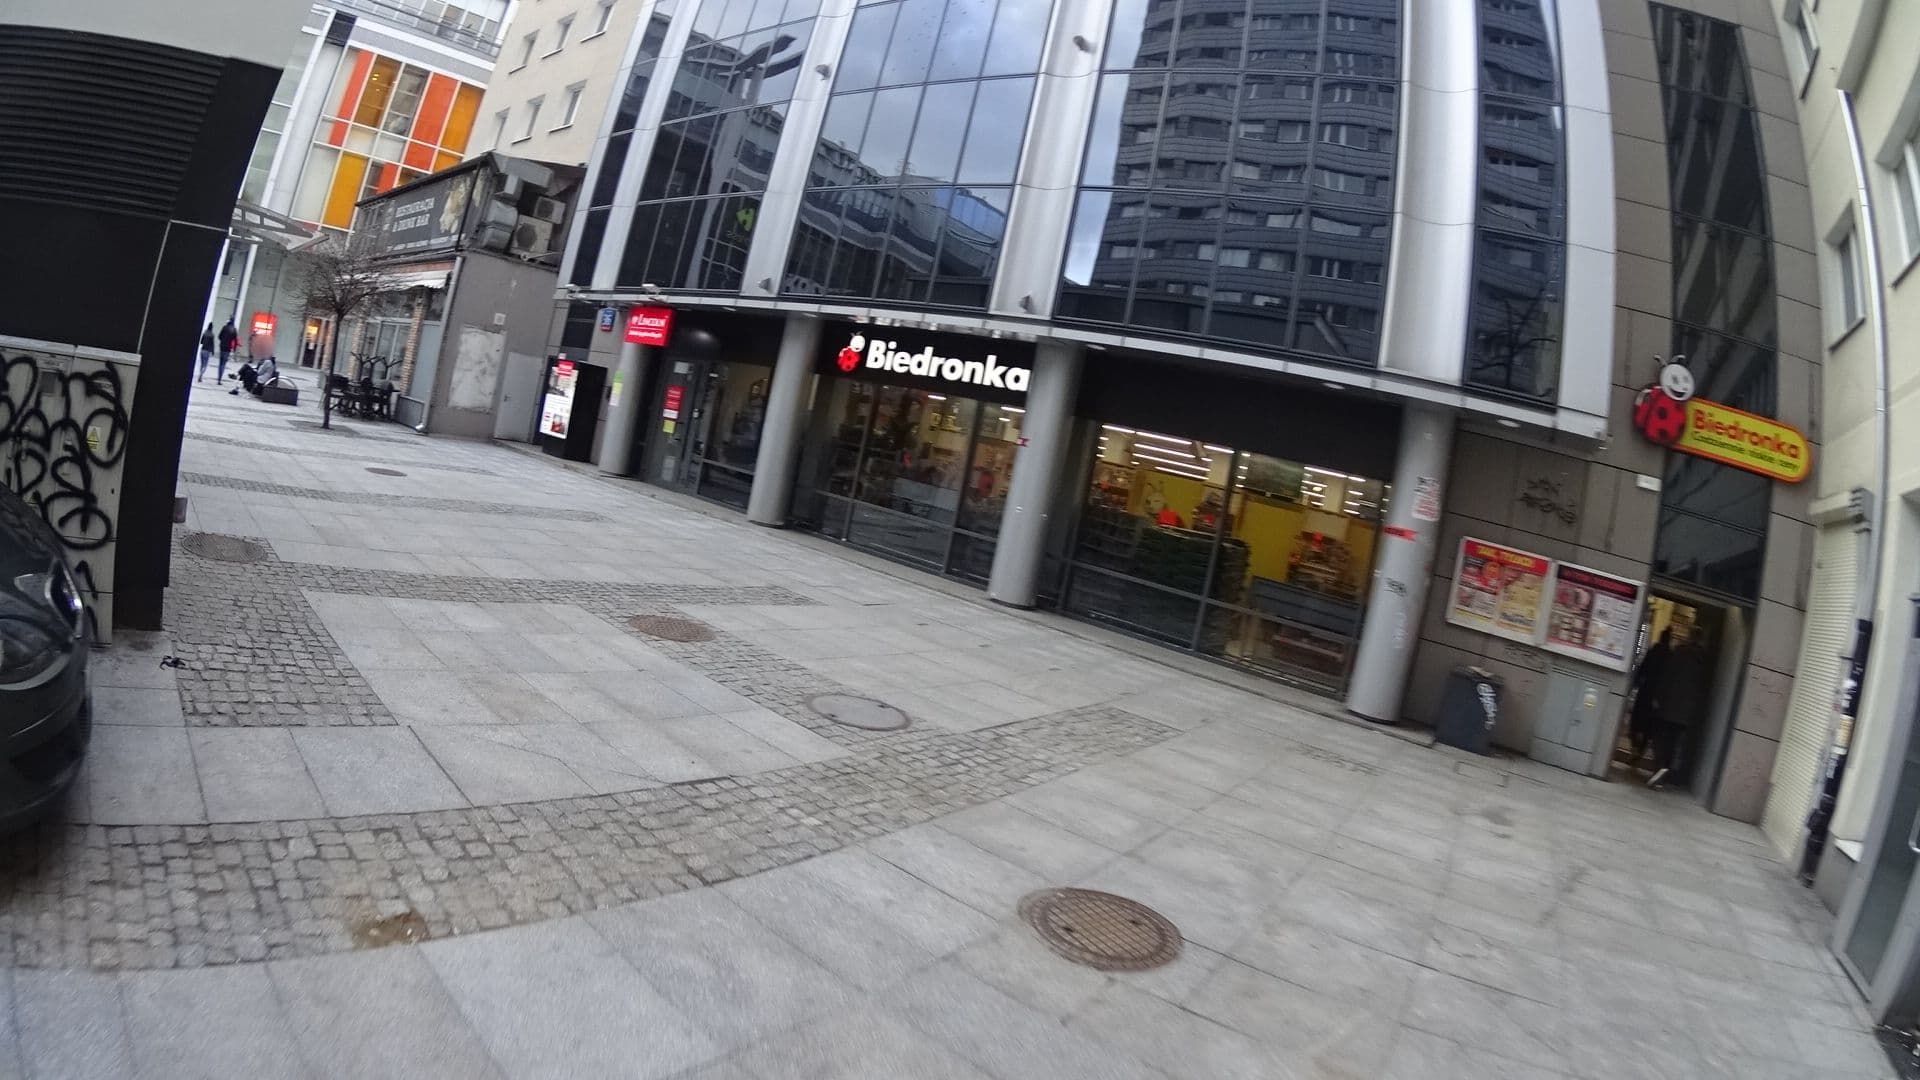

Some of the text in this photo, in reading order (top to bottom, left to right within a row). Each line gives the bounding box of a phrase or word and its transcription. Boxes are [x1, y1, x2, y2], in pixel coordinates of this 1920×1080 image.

[416, 213, 430, 227] BAR
[866, 340, 1031, 391] Biedronka
[1695, 409, 1799, 459] Biedronka
